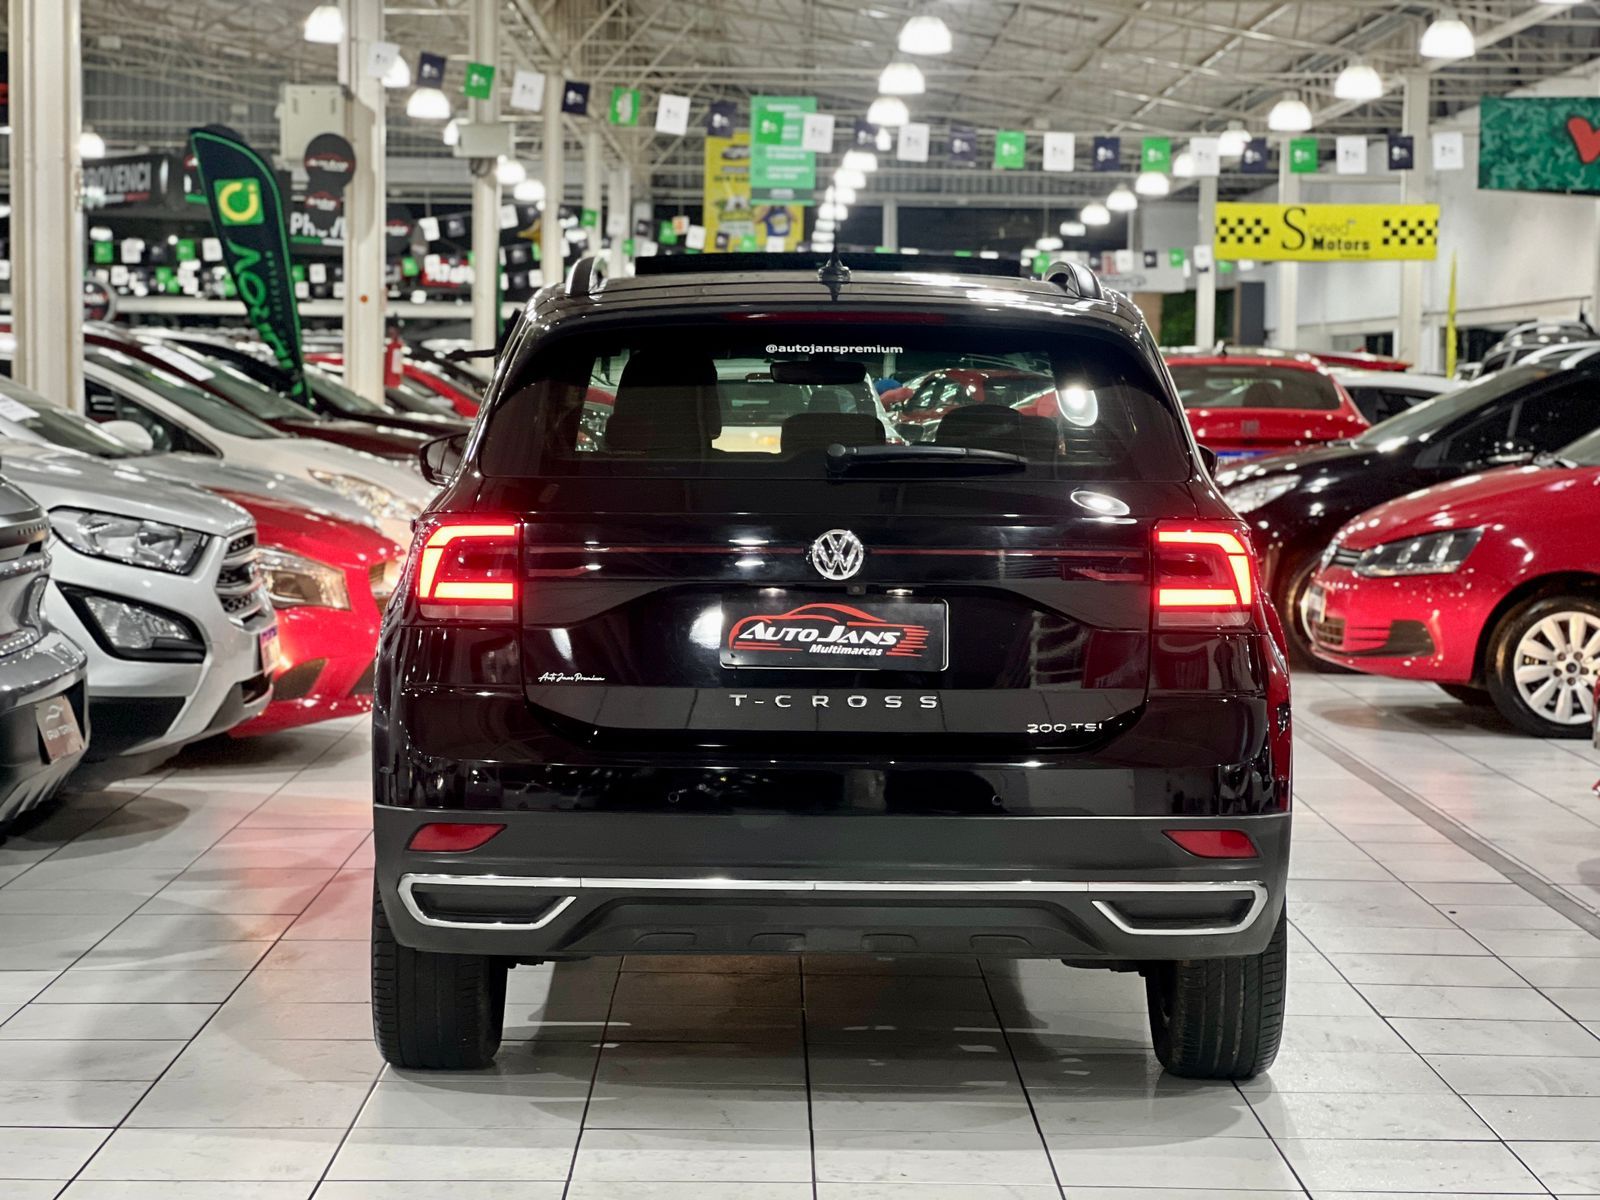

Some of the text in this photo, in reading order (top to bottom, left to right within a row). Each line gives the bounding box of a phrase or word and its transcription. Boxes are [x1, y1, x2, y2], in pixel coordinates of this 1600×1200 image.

[1312, 237, 1370, 251] Motors
[766, 343, 904, 355] @autojanspremium
[809, 643, 884, 657] Multimarcas
[1026, 722, 1103, 733] 200 TSI
